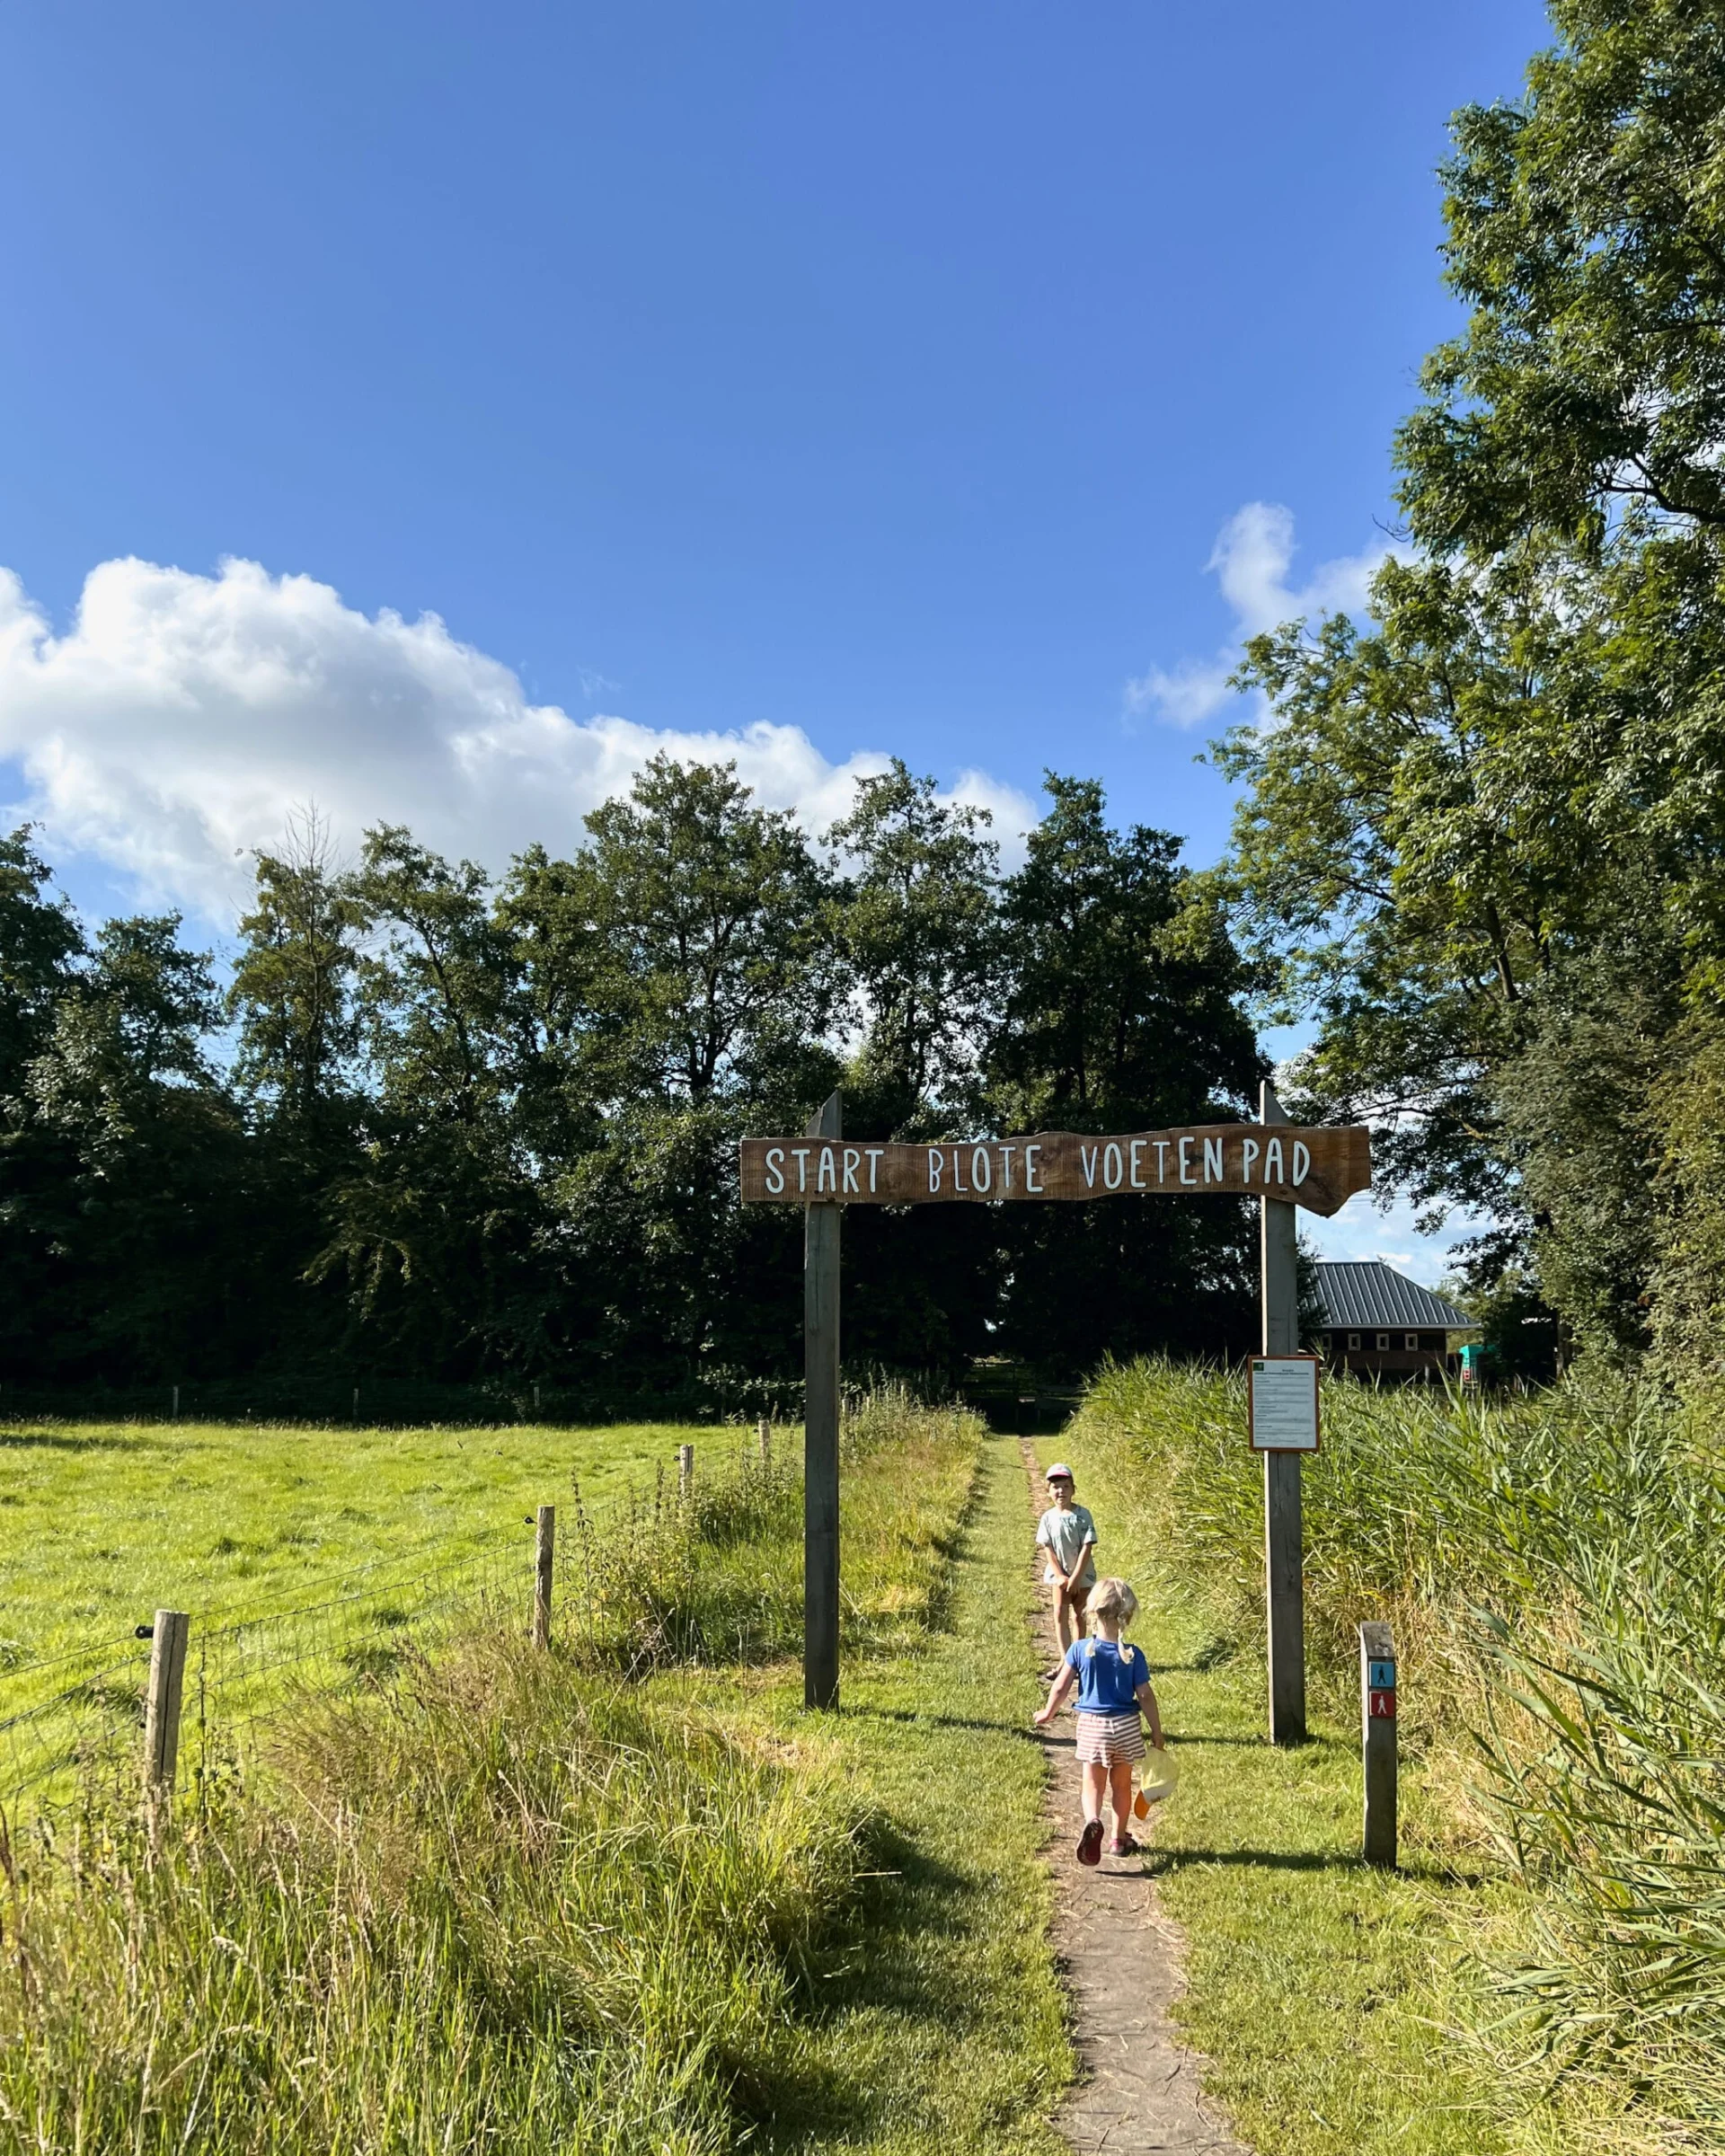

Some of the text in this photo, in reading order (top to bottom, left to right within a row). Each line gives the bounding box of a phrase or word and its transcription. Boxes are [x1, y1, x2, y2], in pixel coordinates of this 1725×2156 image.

[765, 1136, 1311, 1194] START BLOTE VOETEN PAD
